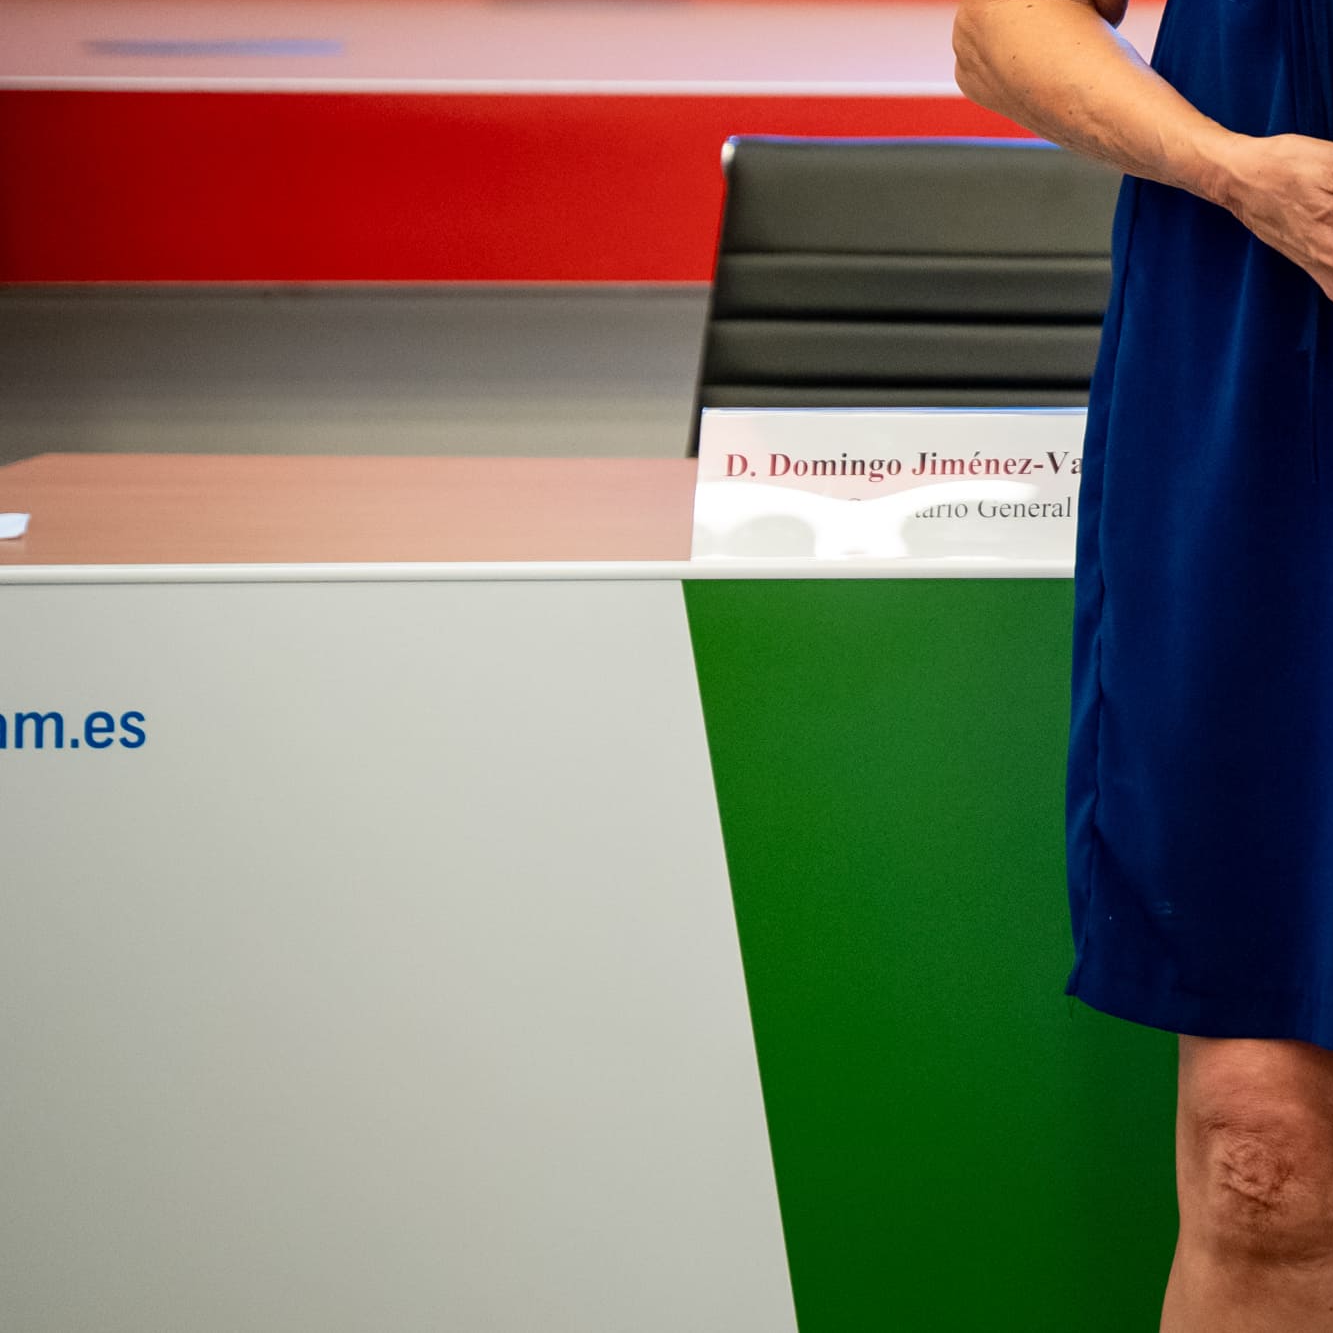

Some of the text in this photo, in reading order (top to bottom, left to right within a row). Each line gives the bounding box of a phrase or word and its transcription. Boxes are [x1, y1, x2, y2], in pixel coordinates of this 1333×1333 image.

[725, 452, 757, 477] D.
[768, 451, 902, 483] Domingo
[978, 495, 1072, 520] General
[0, 711, 147, 749] m.es
